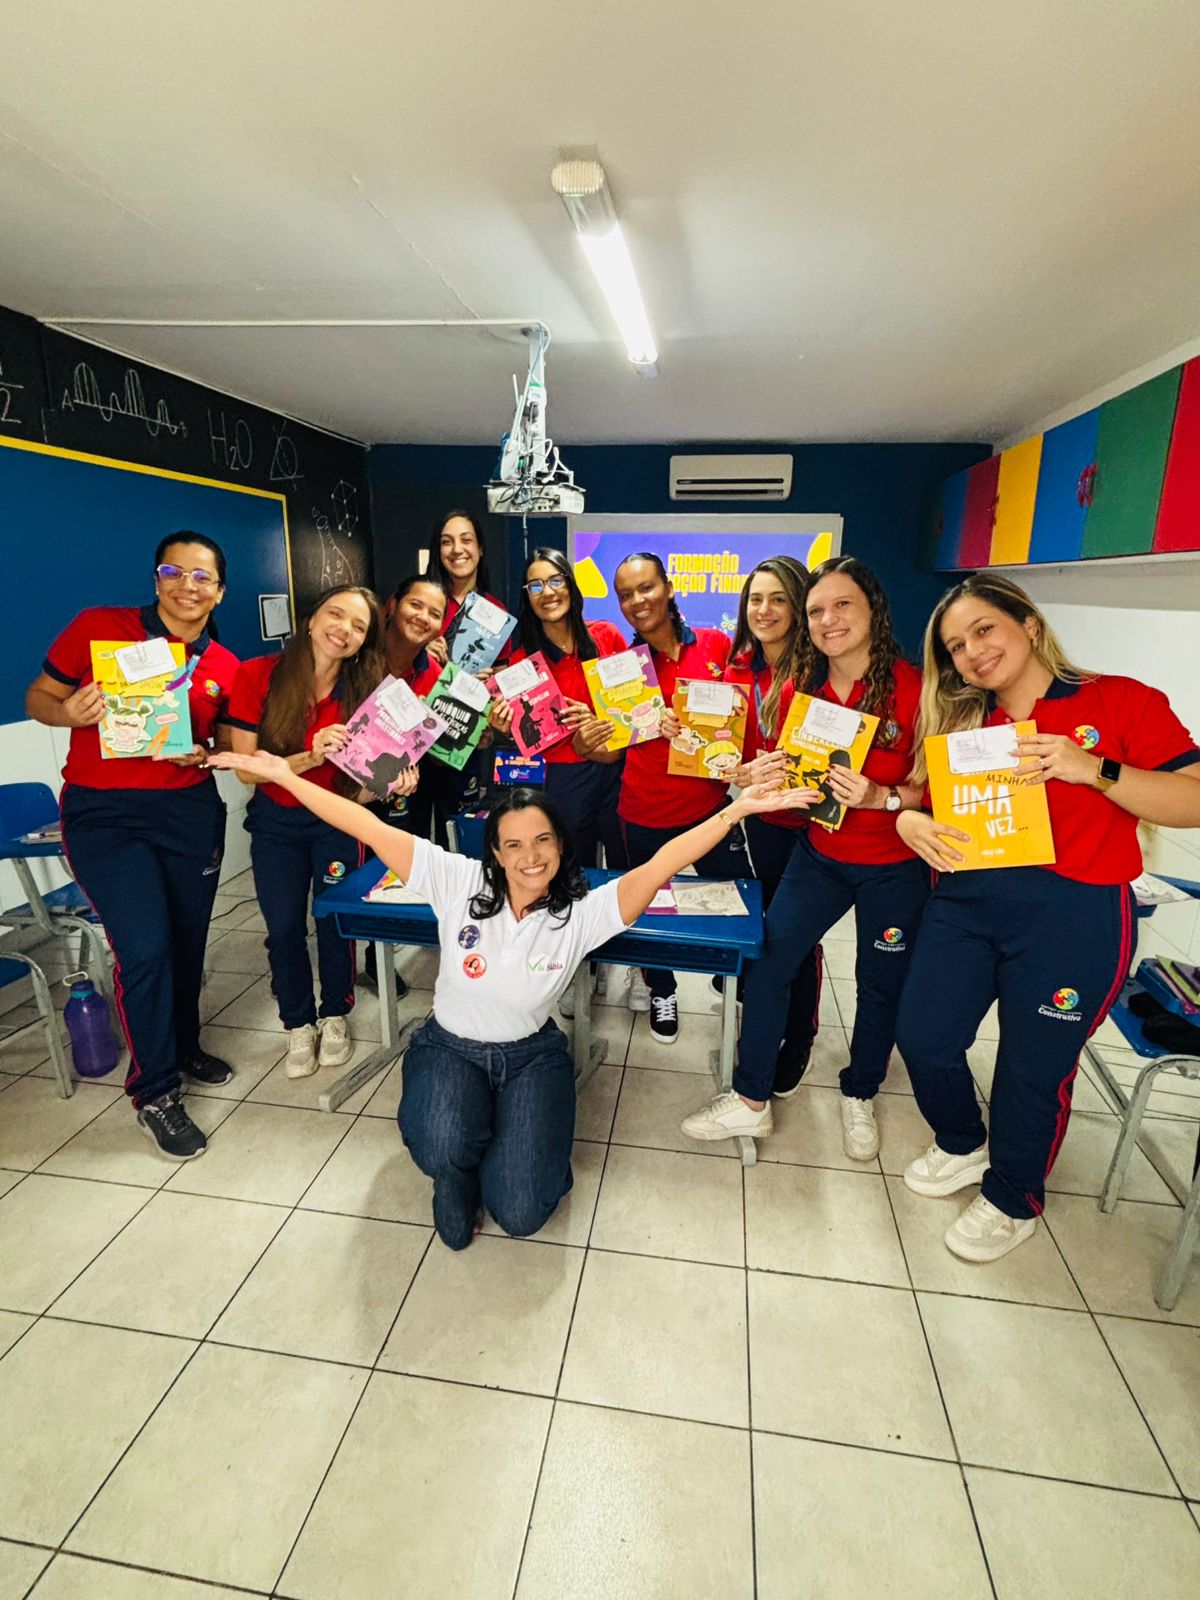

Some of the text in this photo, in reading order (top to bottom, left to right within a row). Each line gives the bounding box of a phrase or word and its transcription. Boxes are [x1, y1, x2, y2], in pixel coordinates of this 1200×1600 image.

[668, 551, 739, 575] FORMAÇÃO
[432, 698, 472, 724] PINÓQUIO
[953, 785, 1012, 816] UMA
[1038, 1006, 1082, 1022] Construtivo
